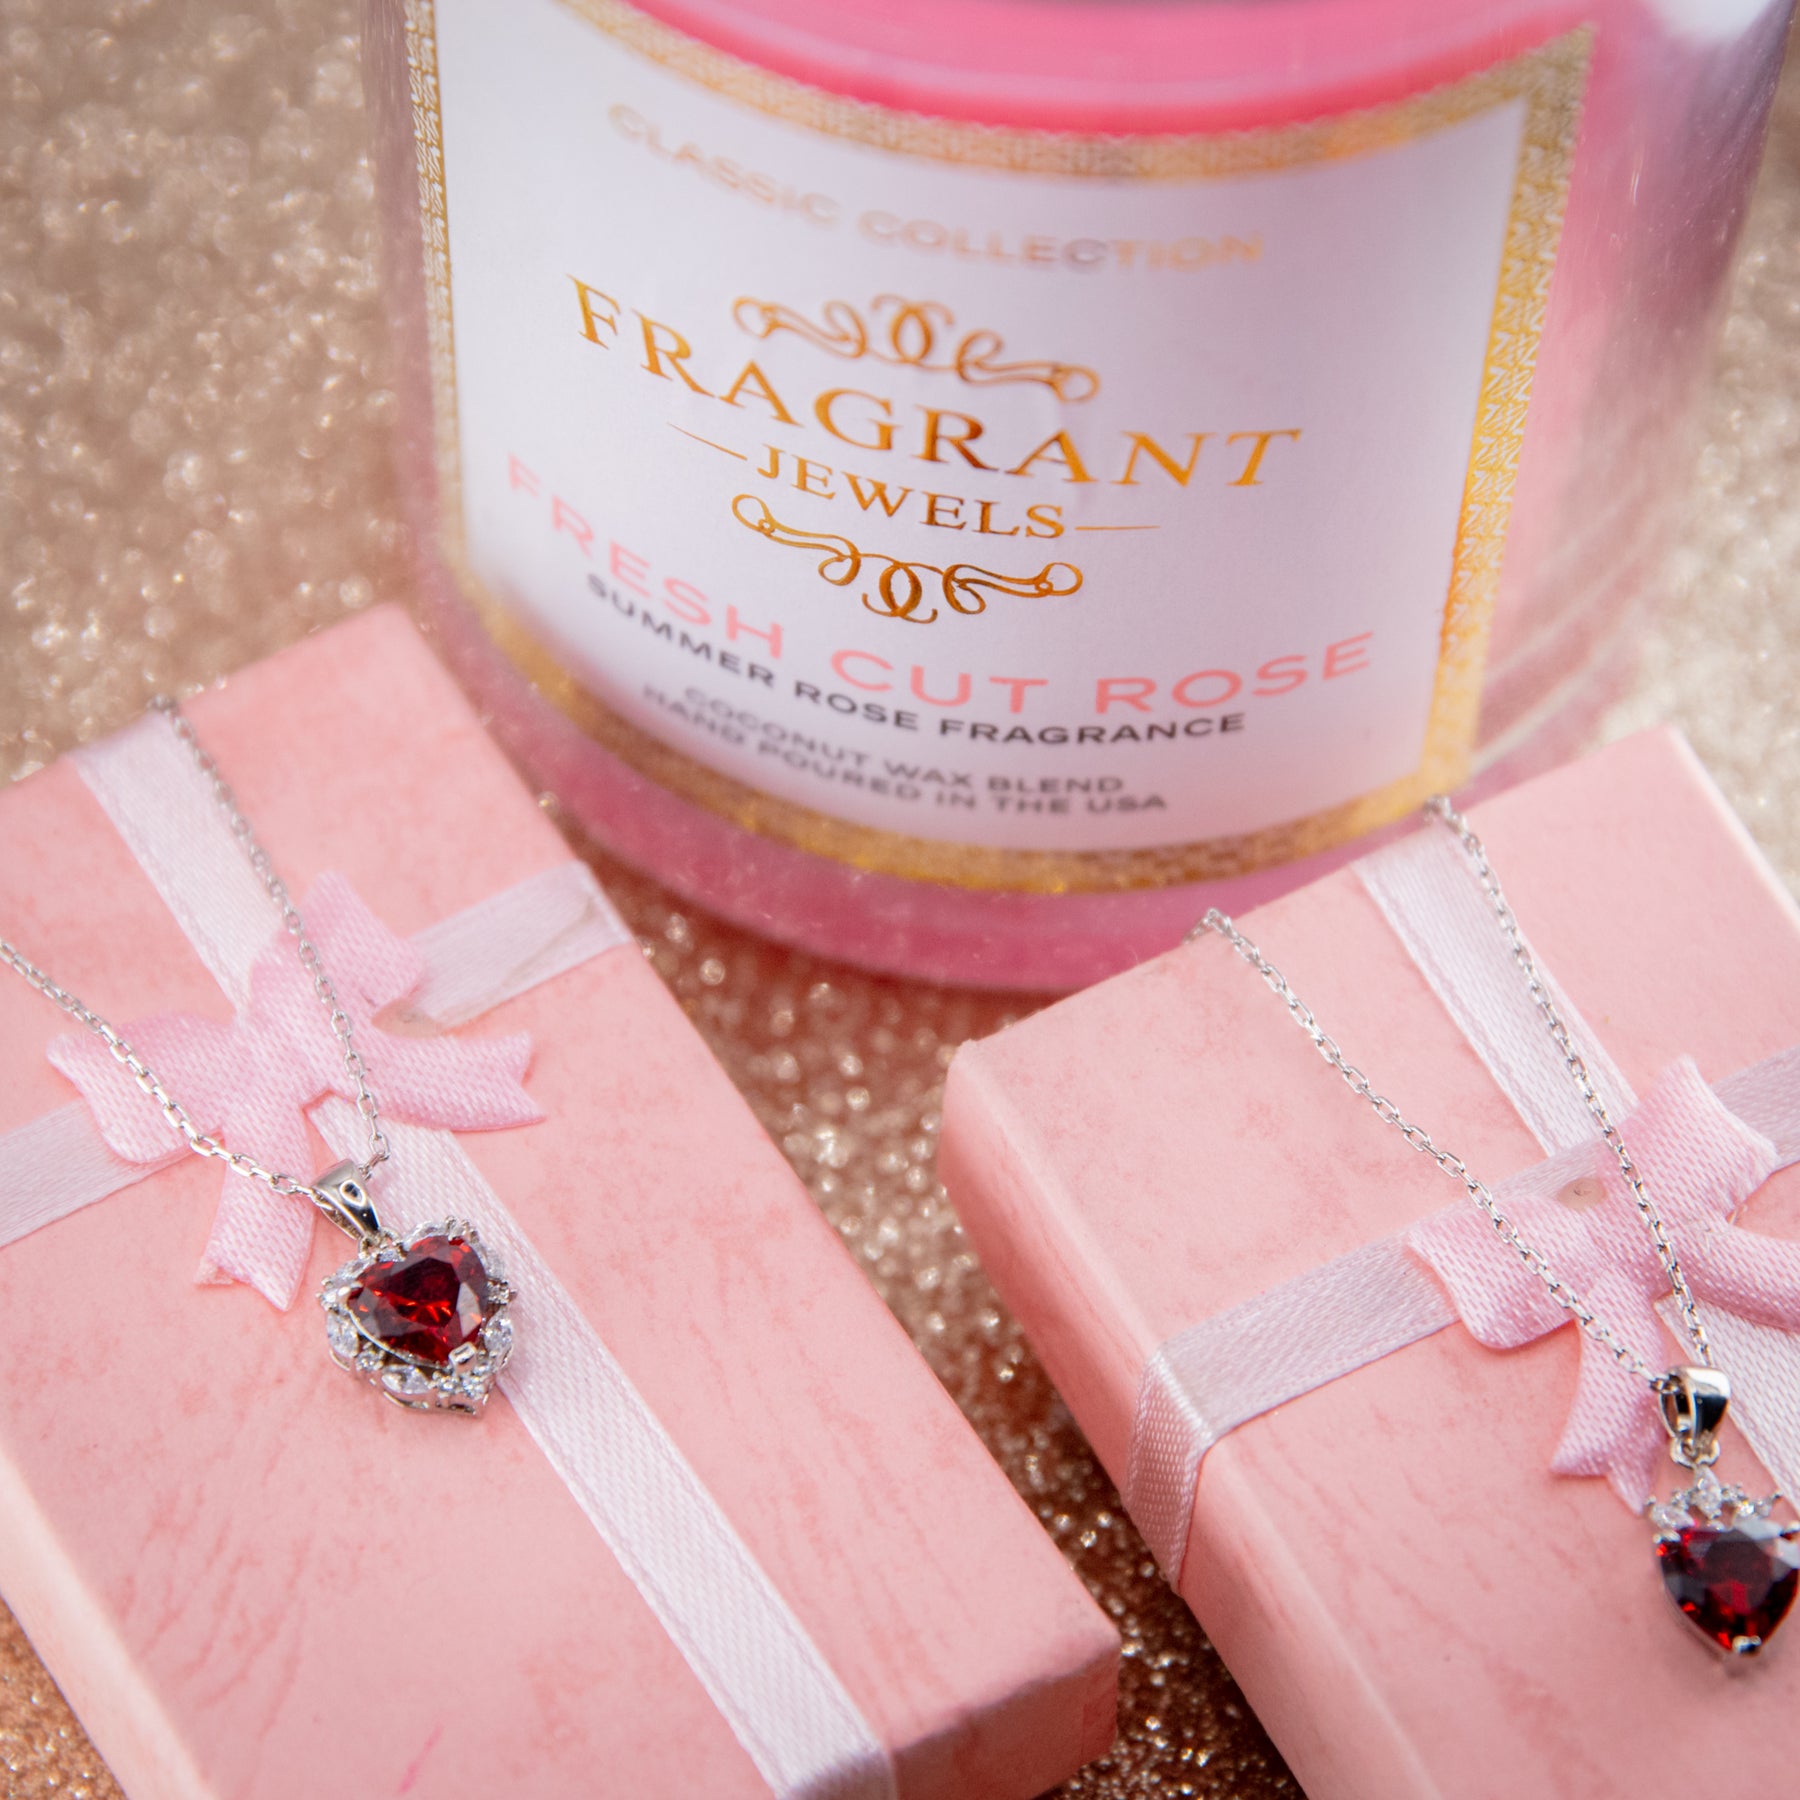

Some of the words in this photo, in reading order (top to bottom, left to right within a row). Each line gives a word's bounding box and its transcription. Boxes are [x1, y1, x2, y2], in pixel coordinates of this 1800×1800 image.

[609, 104, 840, 229] CLASSIC
[858, 209, 1264, 272] COLLECTION
[565, 273, 1302, 488] FRAGRANT
[757, 444, 1065, 539] JEWELS
[508, 453, 783, 660] FRESH
[830, 649, 1049, 714] CUT
[1094, 631, 1374, 715] ROSE
[587, 573, 776, 689] SUMMER
[794, 680, 919, 732] ROSE
[939, 712, 1246, 745] FRAGRANCE
[643, 683, 745, 747] HAND
[757, 739, 921, 802] POURED
[935, 789, 976, 810] IN
[991, 795, 1070, 814] THE
[1087, 794, 1168, 814] USA
[684, 685, 871, 769] COCONUT
[884, 758, 974, 790] WAX
[987, 774, 1124, 793] BLEND
